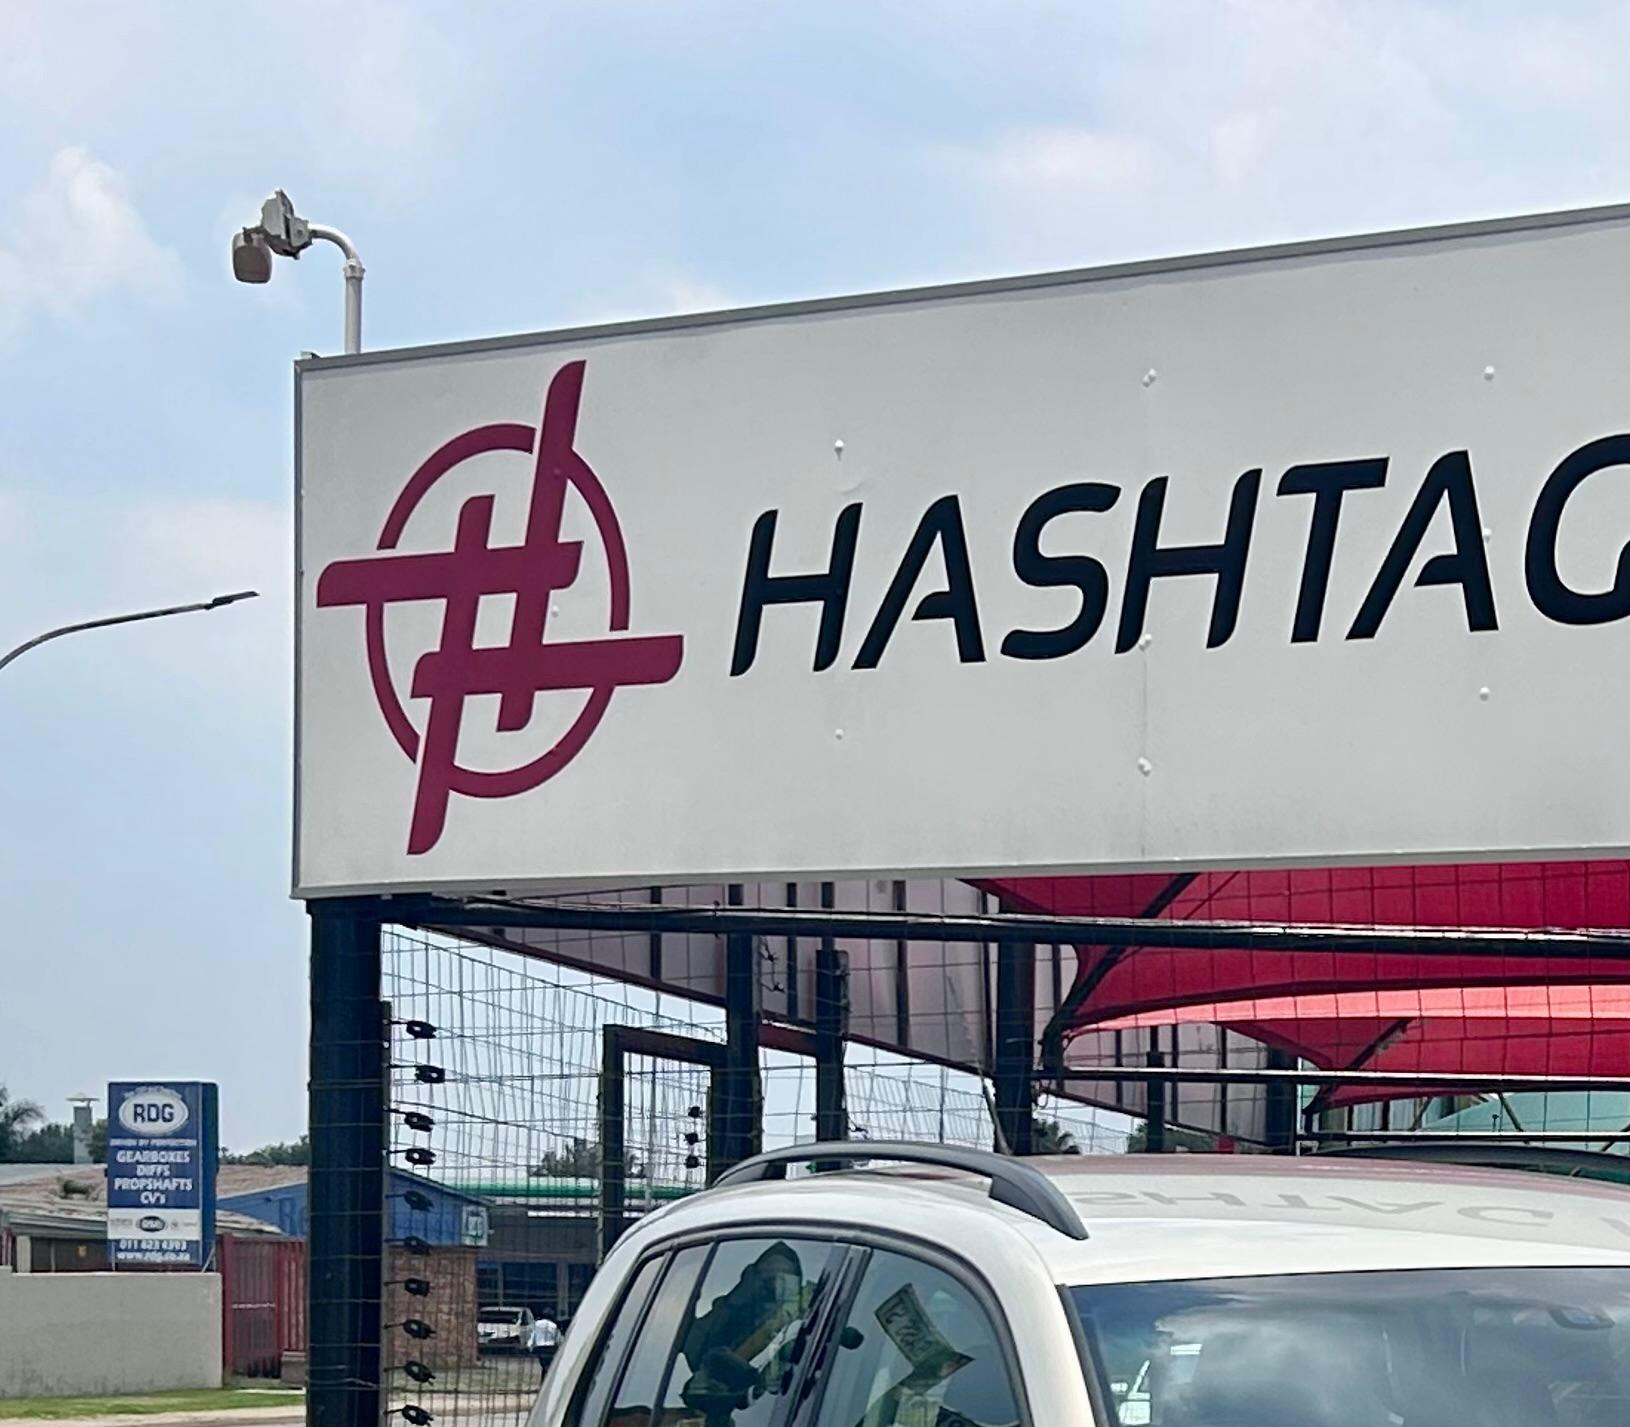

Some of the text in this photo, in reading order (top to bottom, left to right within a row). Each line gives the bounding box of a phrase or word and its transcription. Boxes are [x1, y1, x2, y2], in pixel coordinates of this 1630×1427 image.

[133, 1103, 175, 1123] RDG
[116, 1150, 190, 1164] GEARBOXES
[136, 1164, 170, 1177] DIFFS
[114, 1177, 193, 1191] PROPSHAFTS
